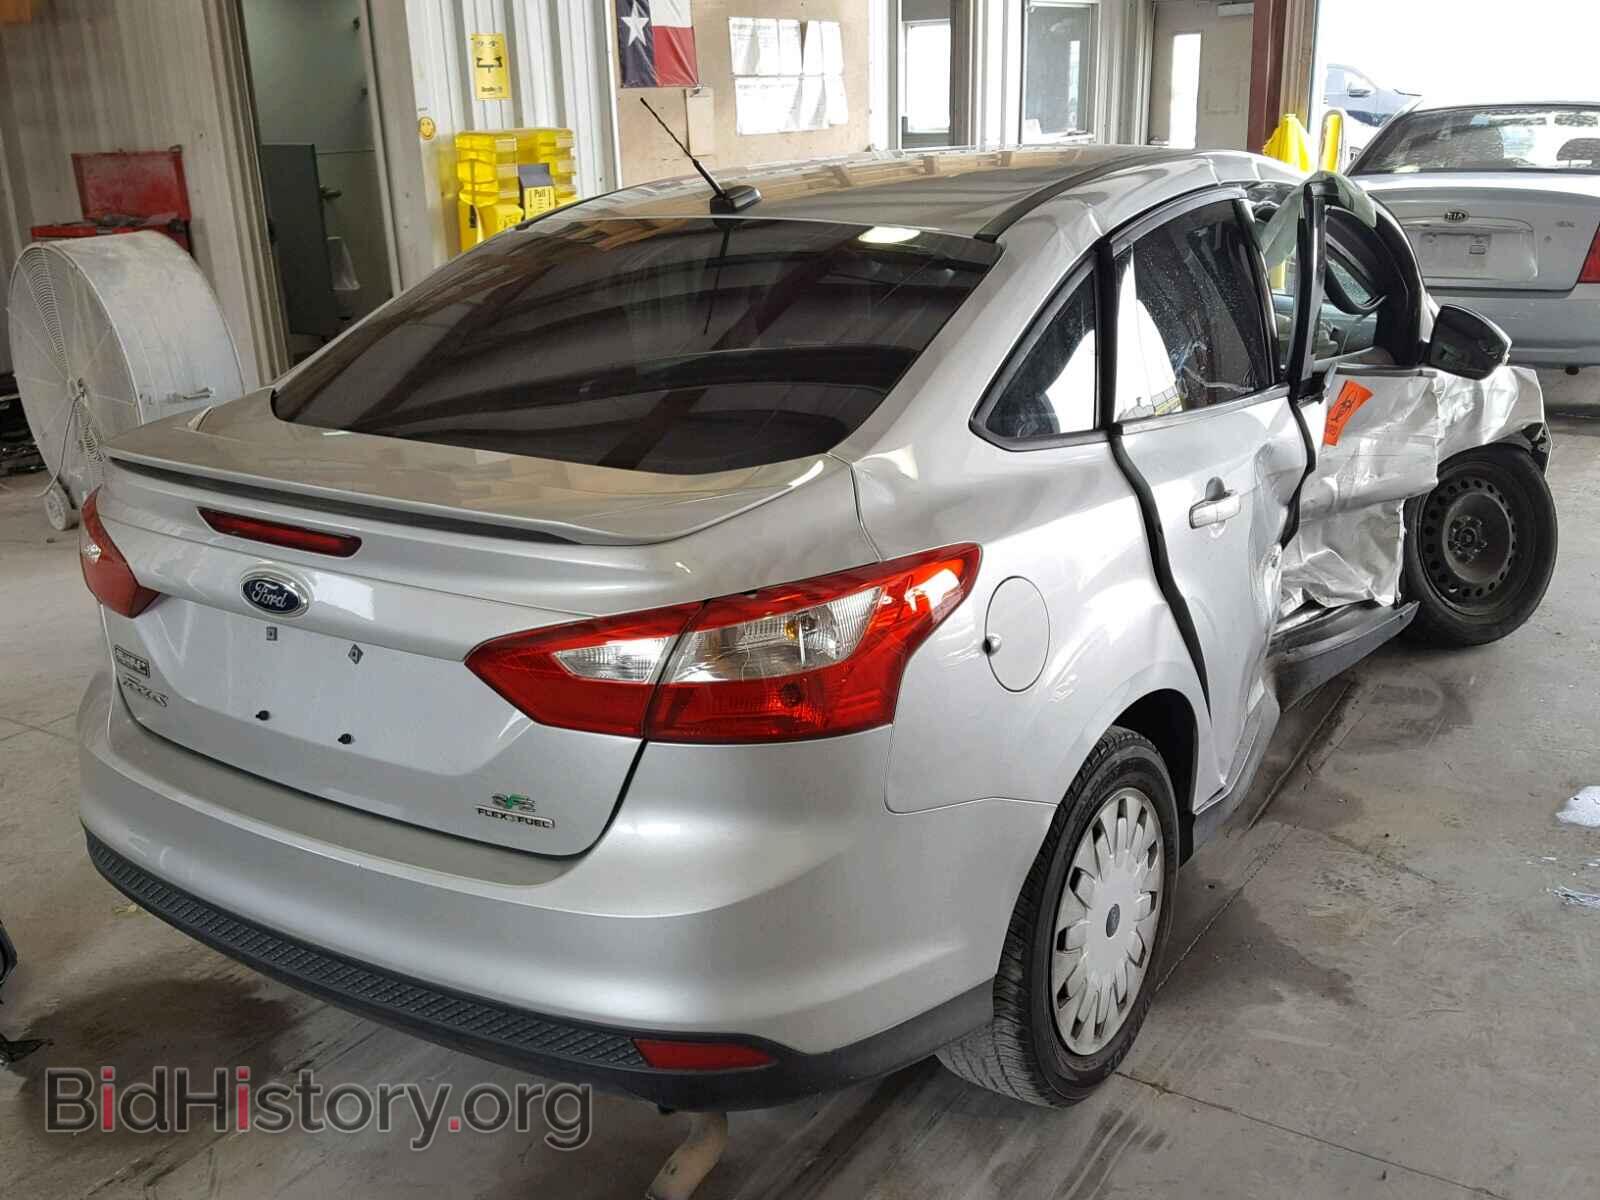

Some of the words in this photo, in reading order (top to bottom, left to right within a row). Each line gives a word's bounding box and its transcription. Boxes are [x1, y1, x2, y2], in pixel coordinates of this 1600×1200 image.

[251, 581, 288, 608] Ford
[477, 807, 508, 821] FLEX
[518, 816, 551, 829] FUEL
